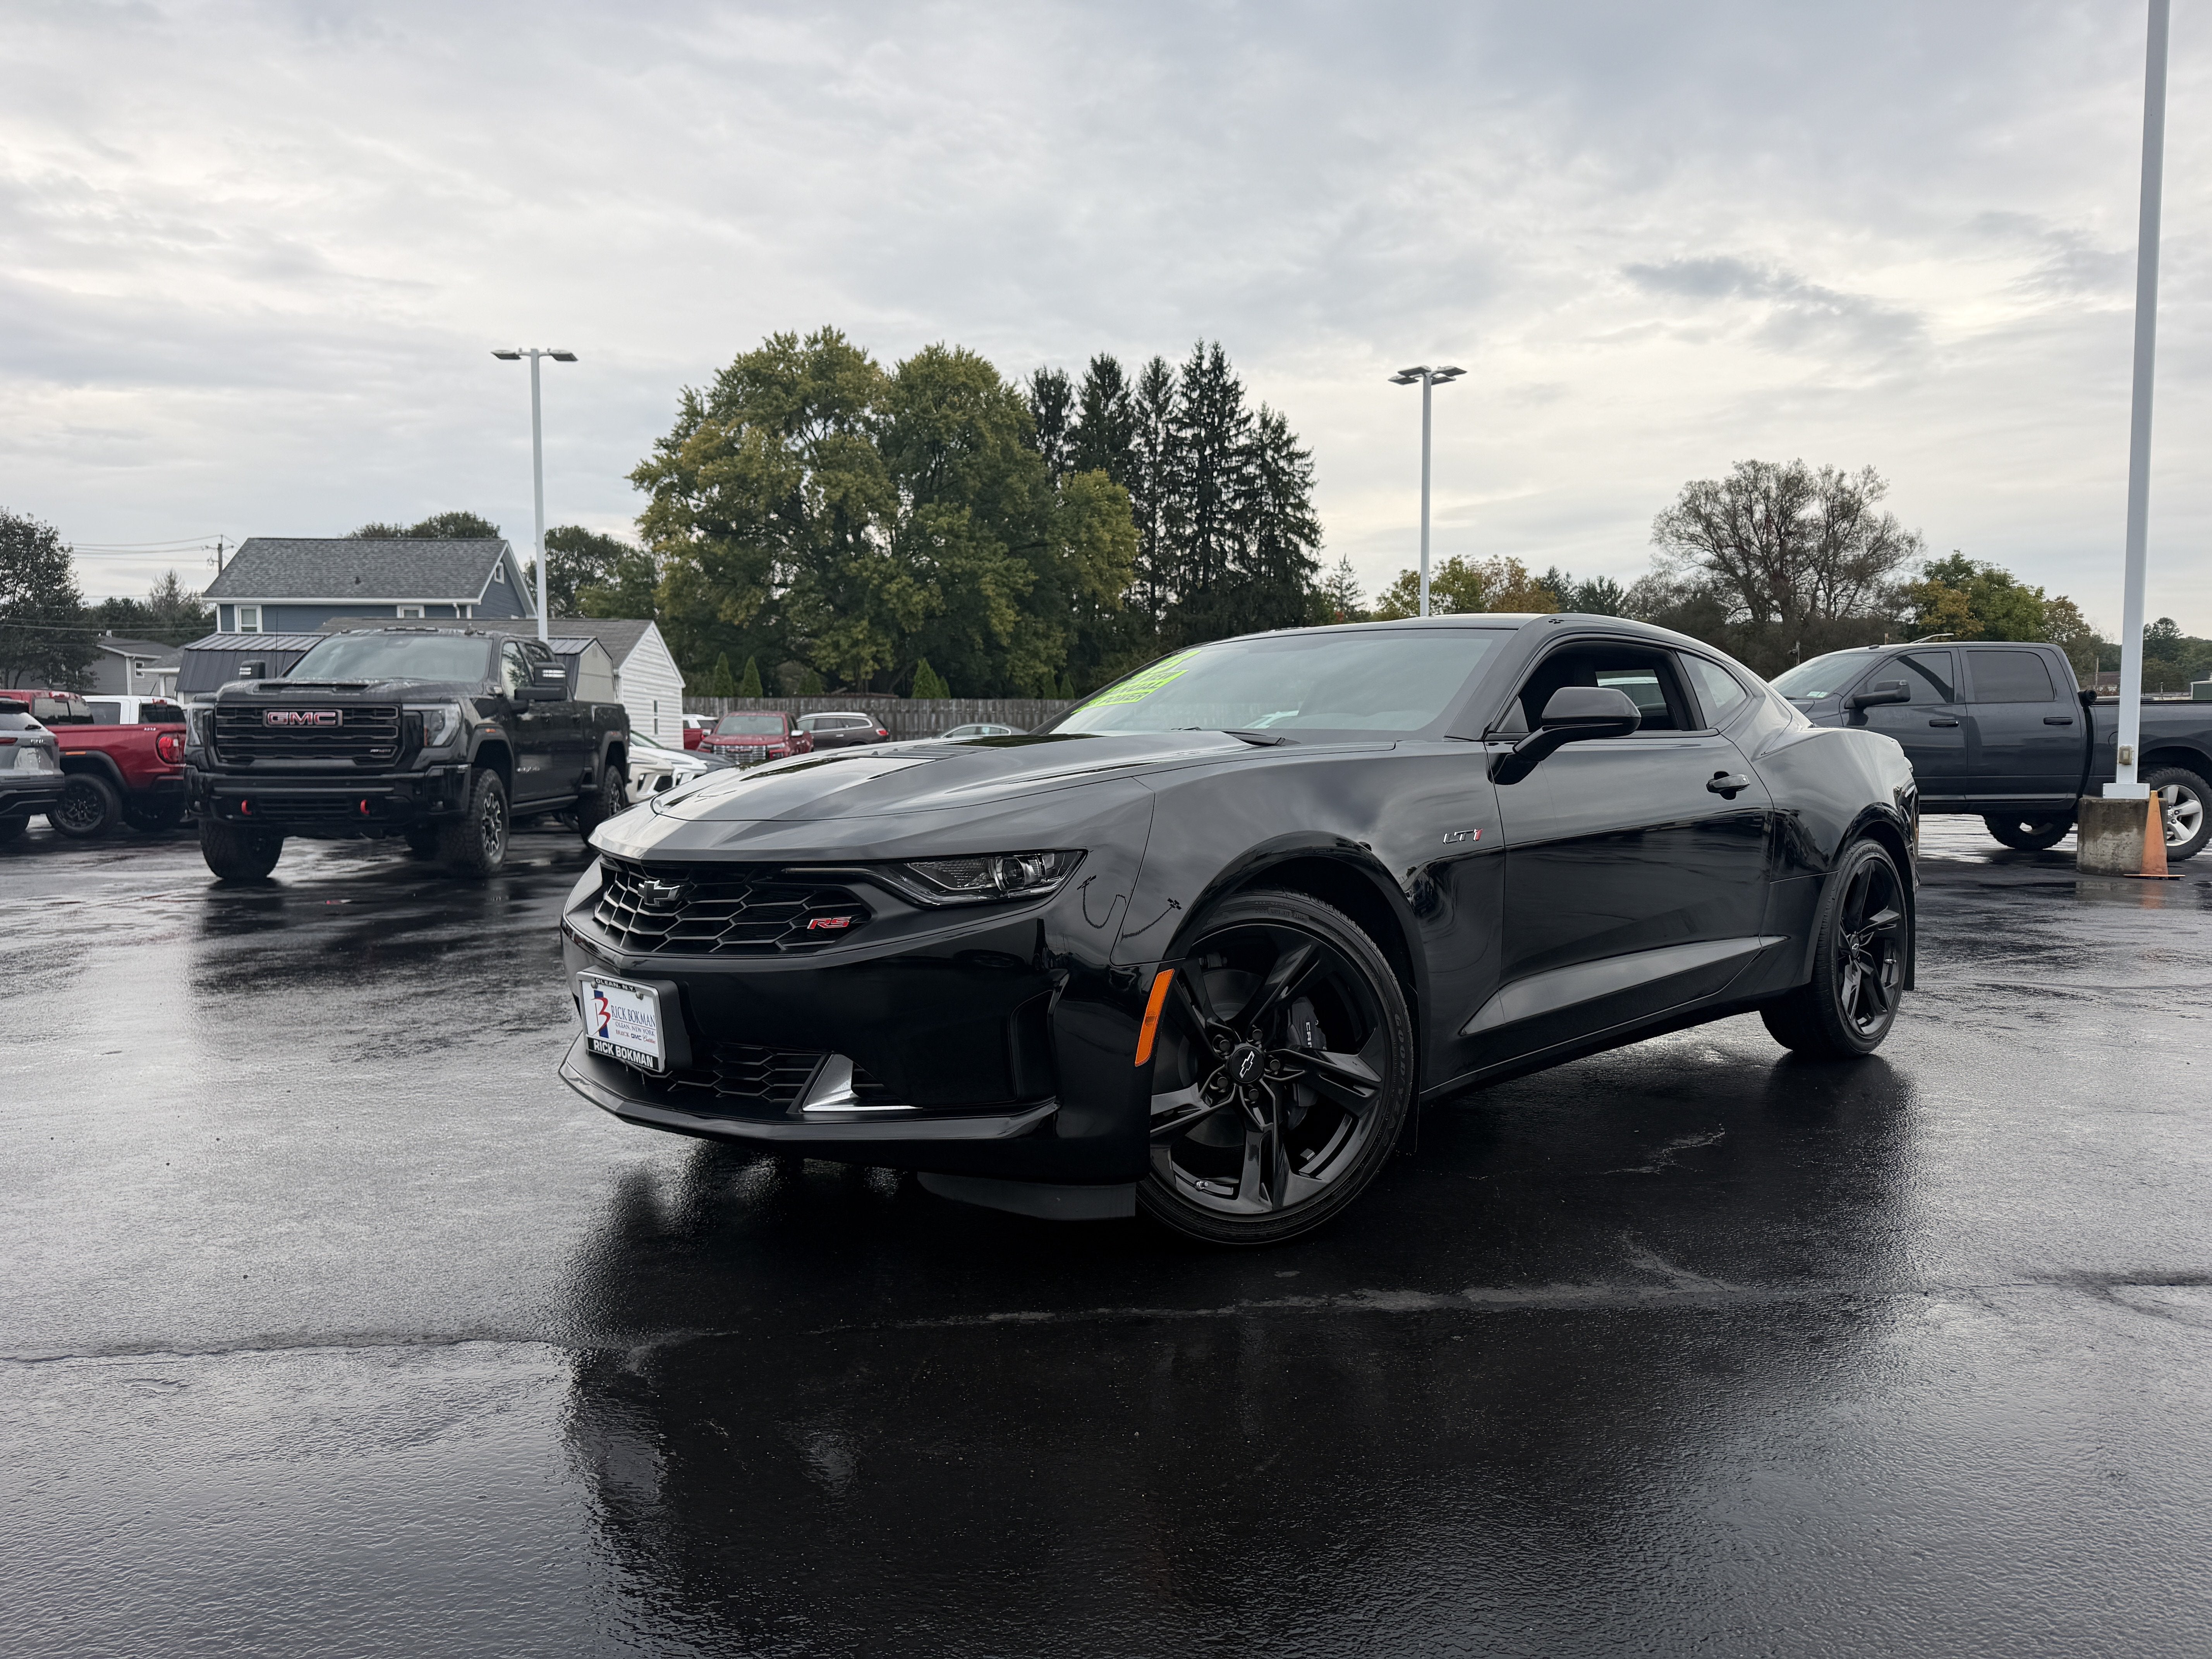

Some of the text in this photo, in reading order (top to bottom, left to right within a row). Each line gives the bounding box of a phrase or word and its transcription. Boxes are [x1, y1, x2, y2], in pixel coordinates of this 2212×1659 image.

[268, 712, 336, 725] GMC
[1443, 829, 1483, 844] LT1
[807, 917, 852, 929] RS
[611, 1005, 656, 1027] RICK BOKMAN
[642, 1028, 655, 1036] YORK
[594, 1039, 654, 1068] RICK BOKMAN
[1382, 1013, 1406, 1147] GOODYEAR
